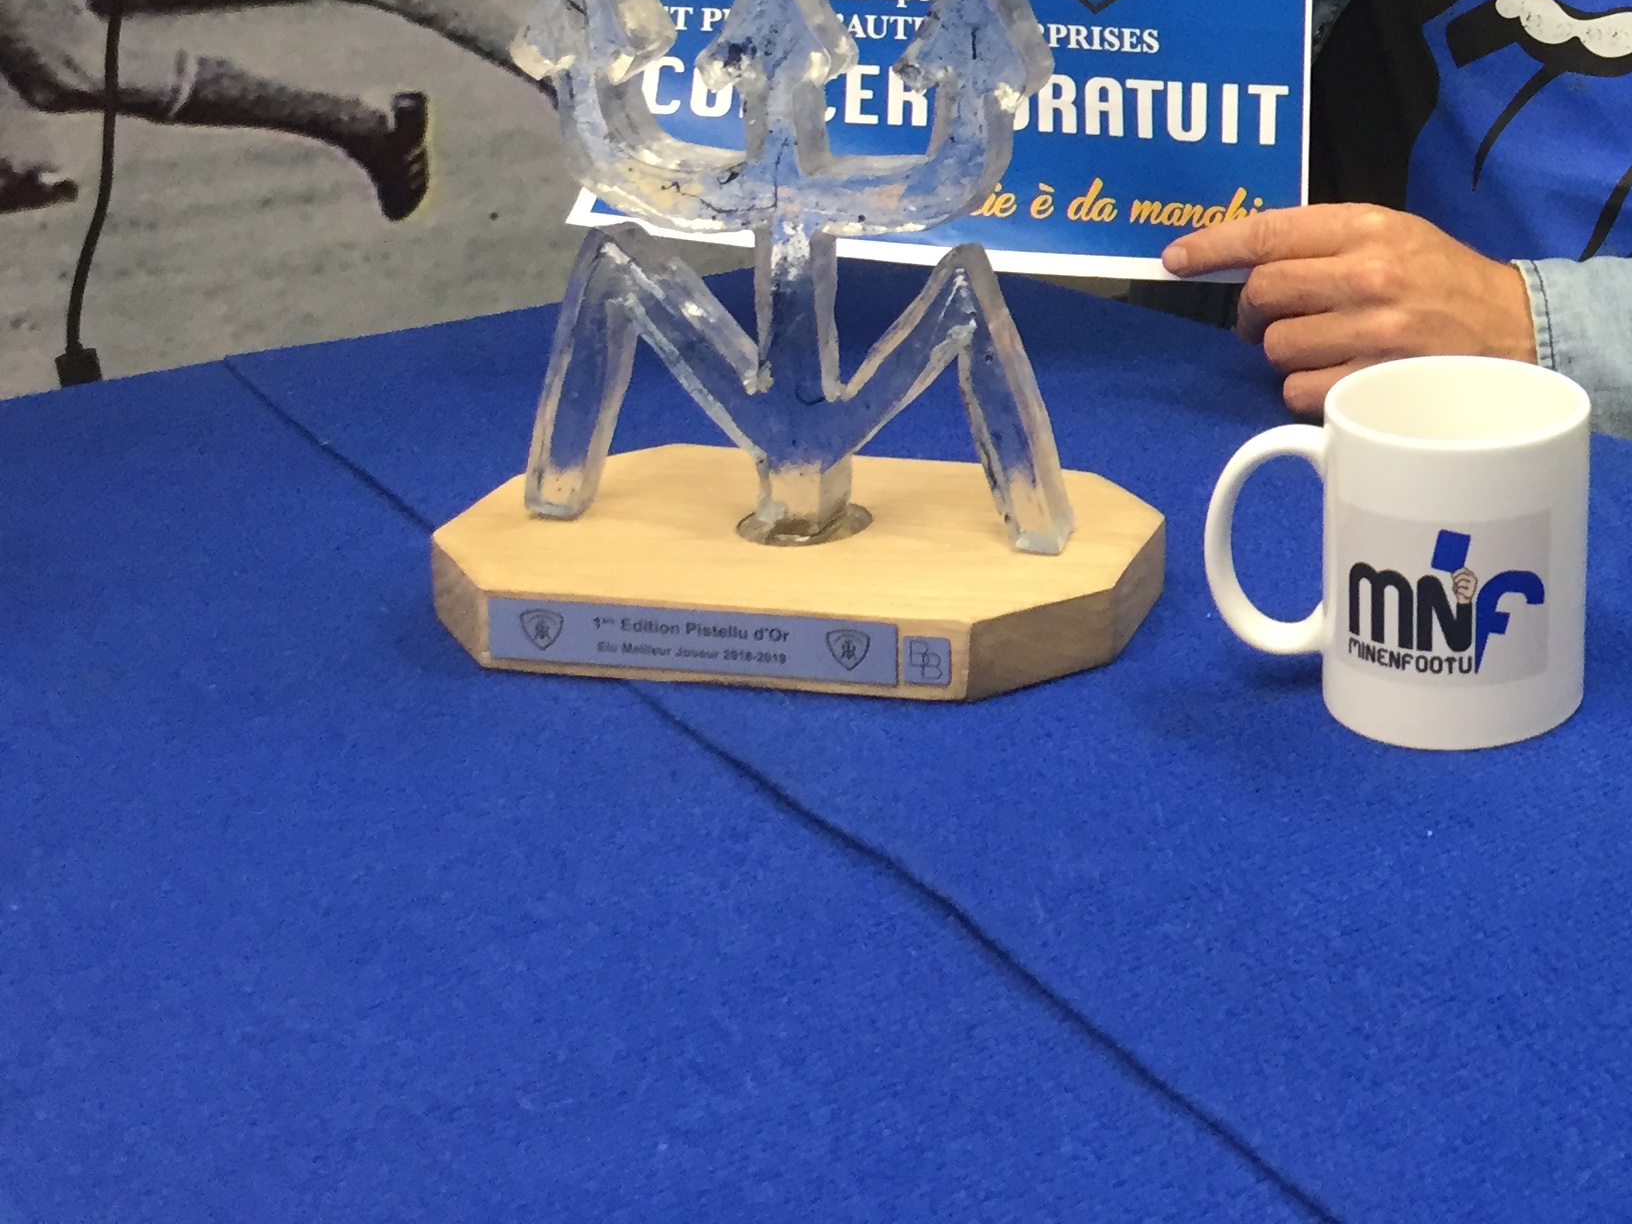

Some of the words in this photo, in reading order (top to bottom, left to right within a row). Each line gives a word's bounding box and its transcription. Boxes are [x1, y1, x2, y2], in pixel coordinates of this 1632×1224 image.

[1029, 182, 1055, 219] è
[1066, 177, 1119, 223] da
[620, 617, 680, 636] Edition
[685, 621, 748, 641] Pistellu
[753, 626, 790, 644] d'Or
[1348, 637, 1472, 675] MINENFOOTU
